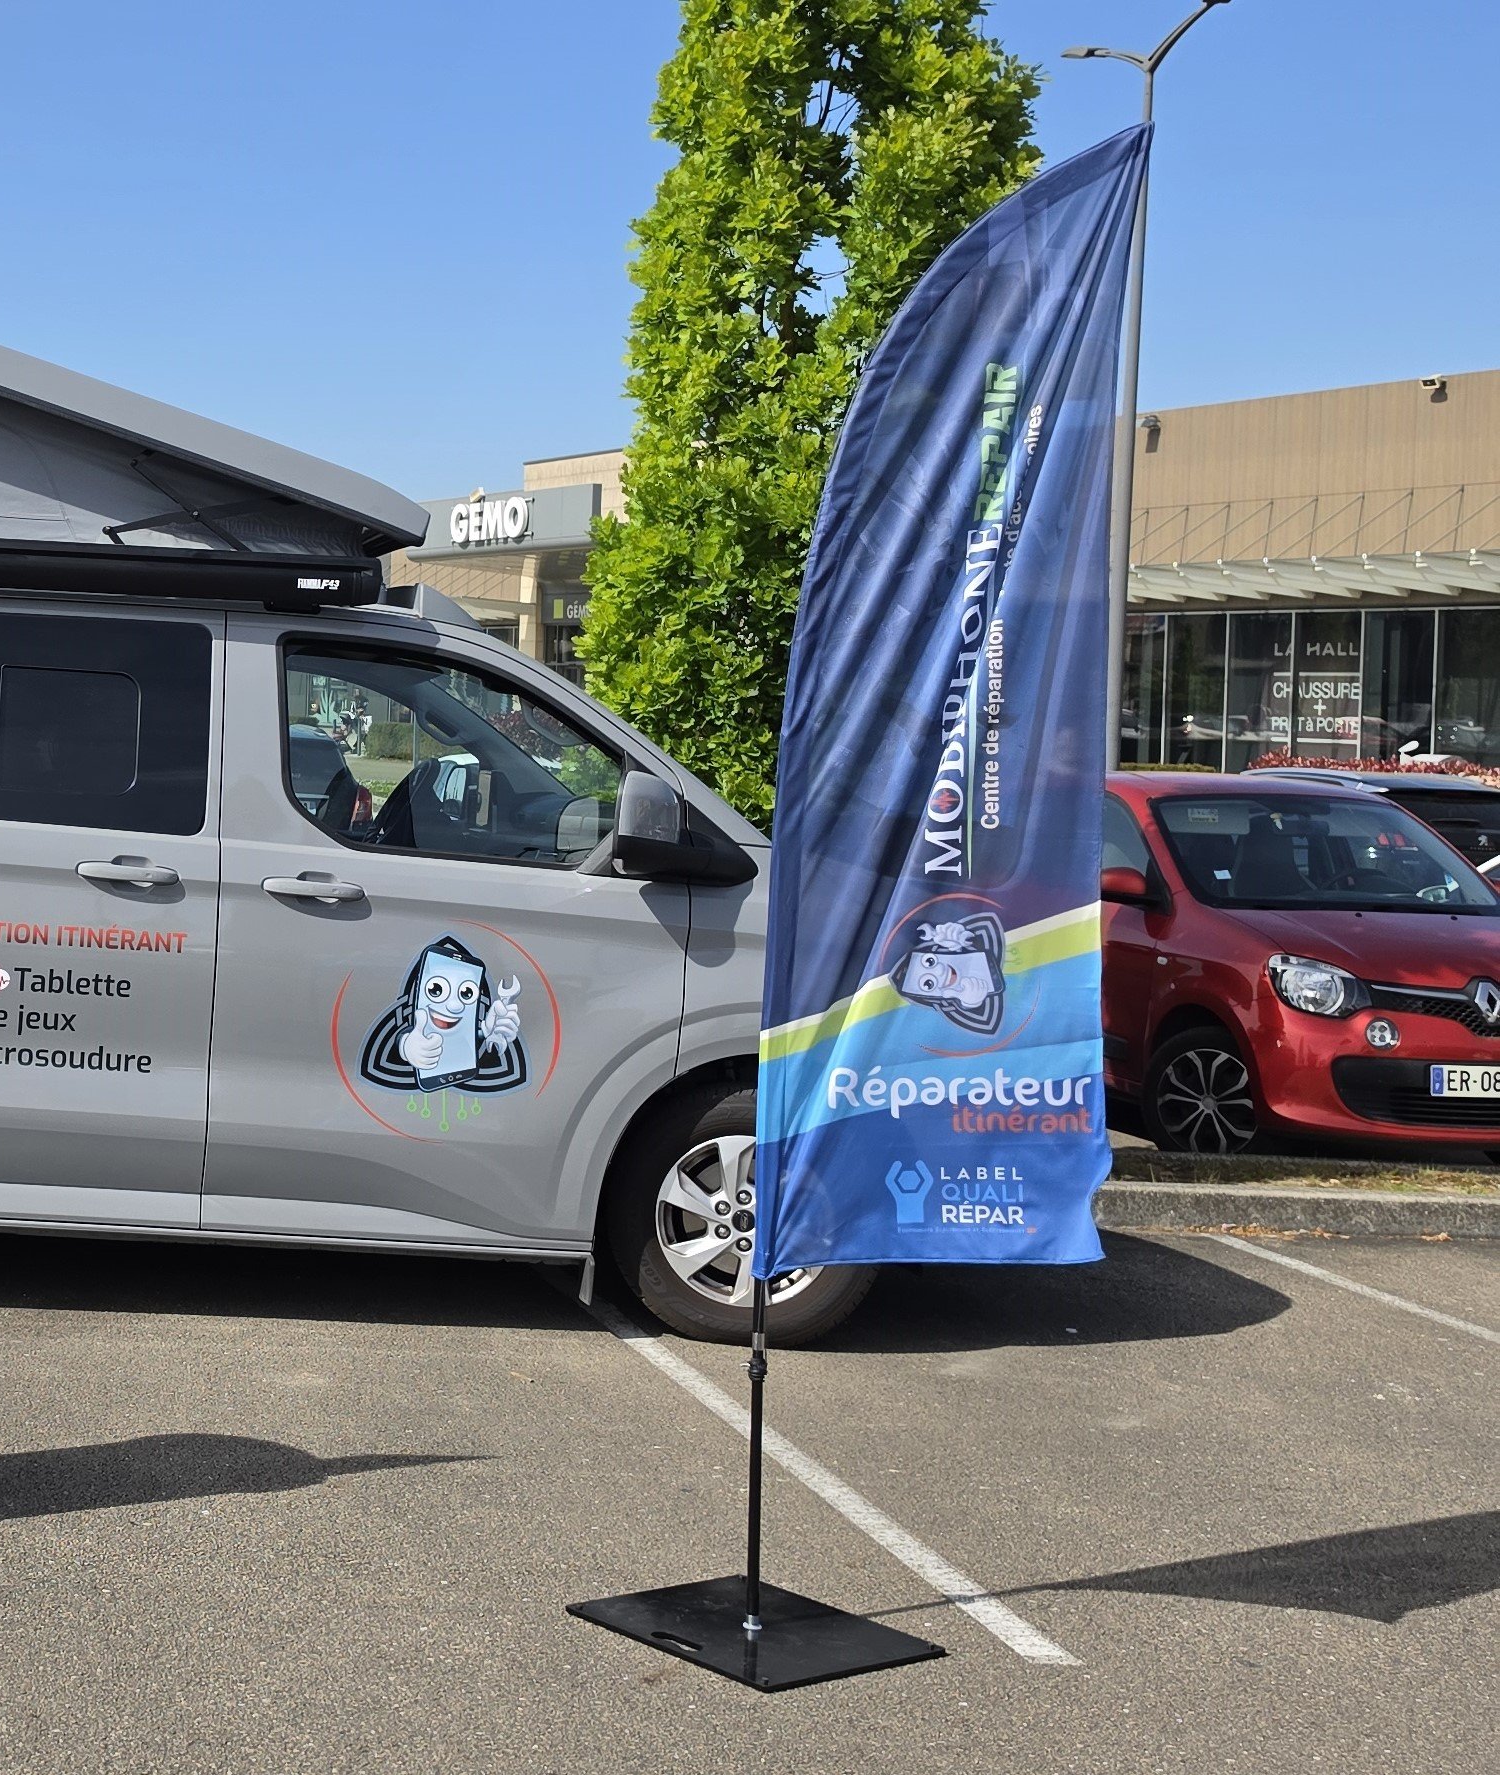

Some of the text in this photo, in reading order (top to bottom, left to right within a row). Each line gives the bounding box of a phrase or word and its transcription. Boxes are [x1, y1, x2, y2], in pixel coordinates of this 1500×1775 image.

[450, 487, 529, 544] GÉMO
[983, 618, 1005, 725] réparation
[1272, 681, 1361, 701] CHUSSURE
[982, 735, 1001, 756] de
[980, 761, 1001, 830] Centre
[56, 921, 188, 954] ITINÉRANT
[14, 966, 133, 998] Tablette
[17, 1004, 77, 1036] jeux
[827, 1064, 1092, 1119] Réparateur
[952, 1104, 1094, 1135] itinérant
[940, 1166, 1024, 1181] LABEL
[940, 1183, 1025, 1202] QUALI
[940, 1200, 1025, 1225] RÉPAR
